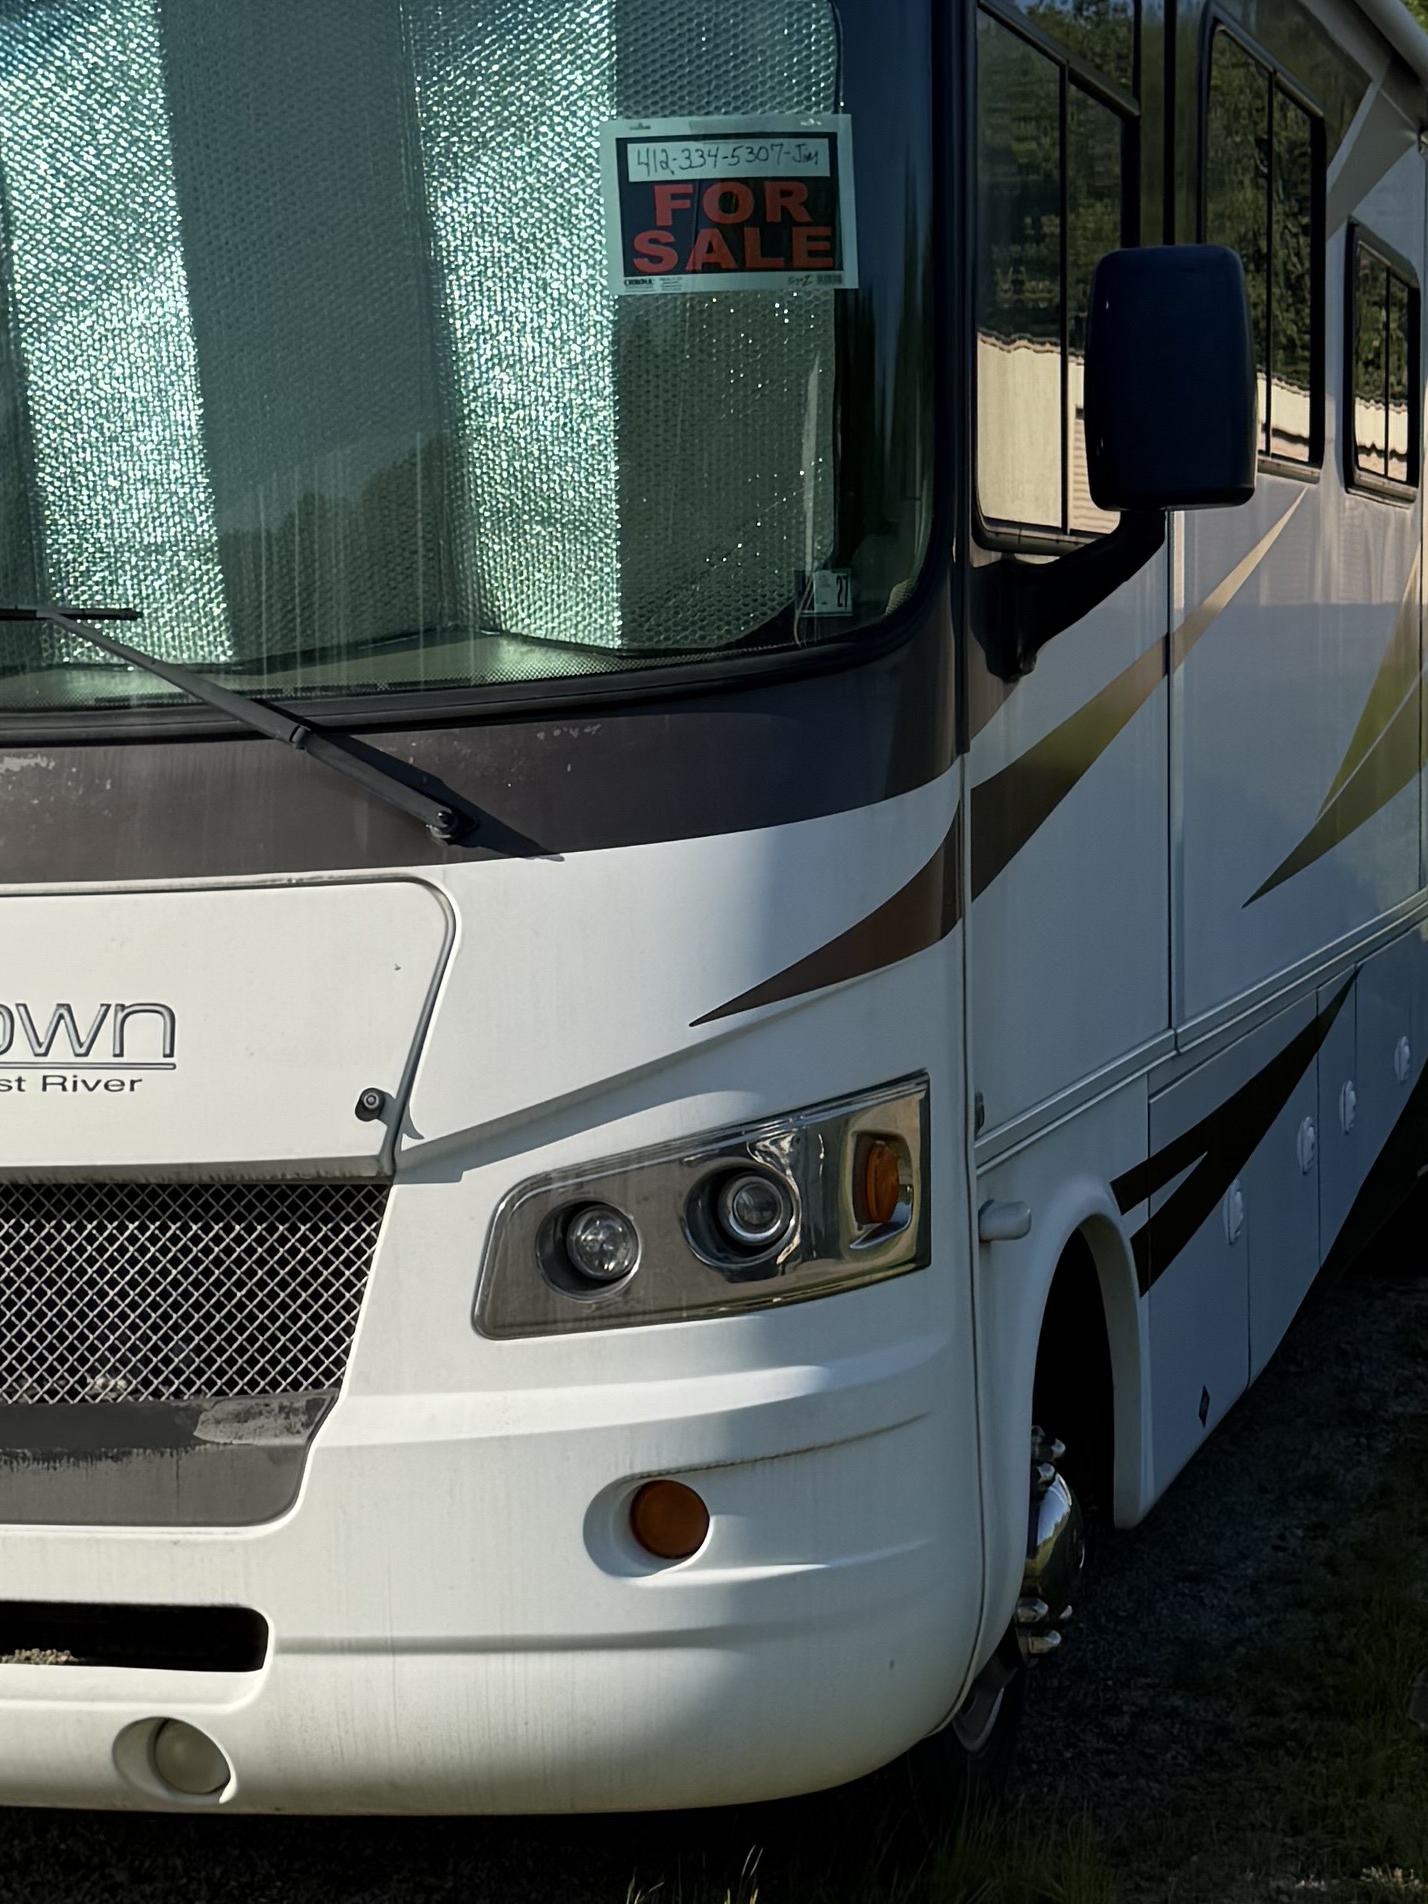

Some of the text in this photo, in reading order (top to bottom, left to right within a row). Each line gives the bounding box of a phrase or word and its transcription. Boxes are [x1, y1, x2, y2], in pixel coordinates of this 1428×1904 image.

[653, 181, 813, 226] FOR
[632, 226, 834, 273] SALE
[41, 1074, 144, 1093] River
